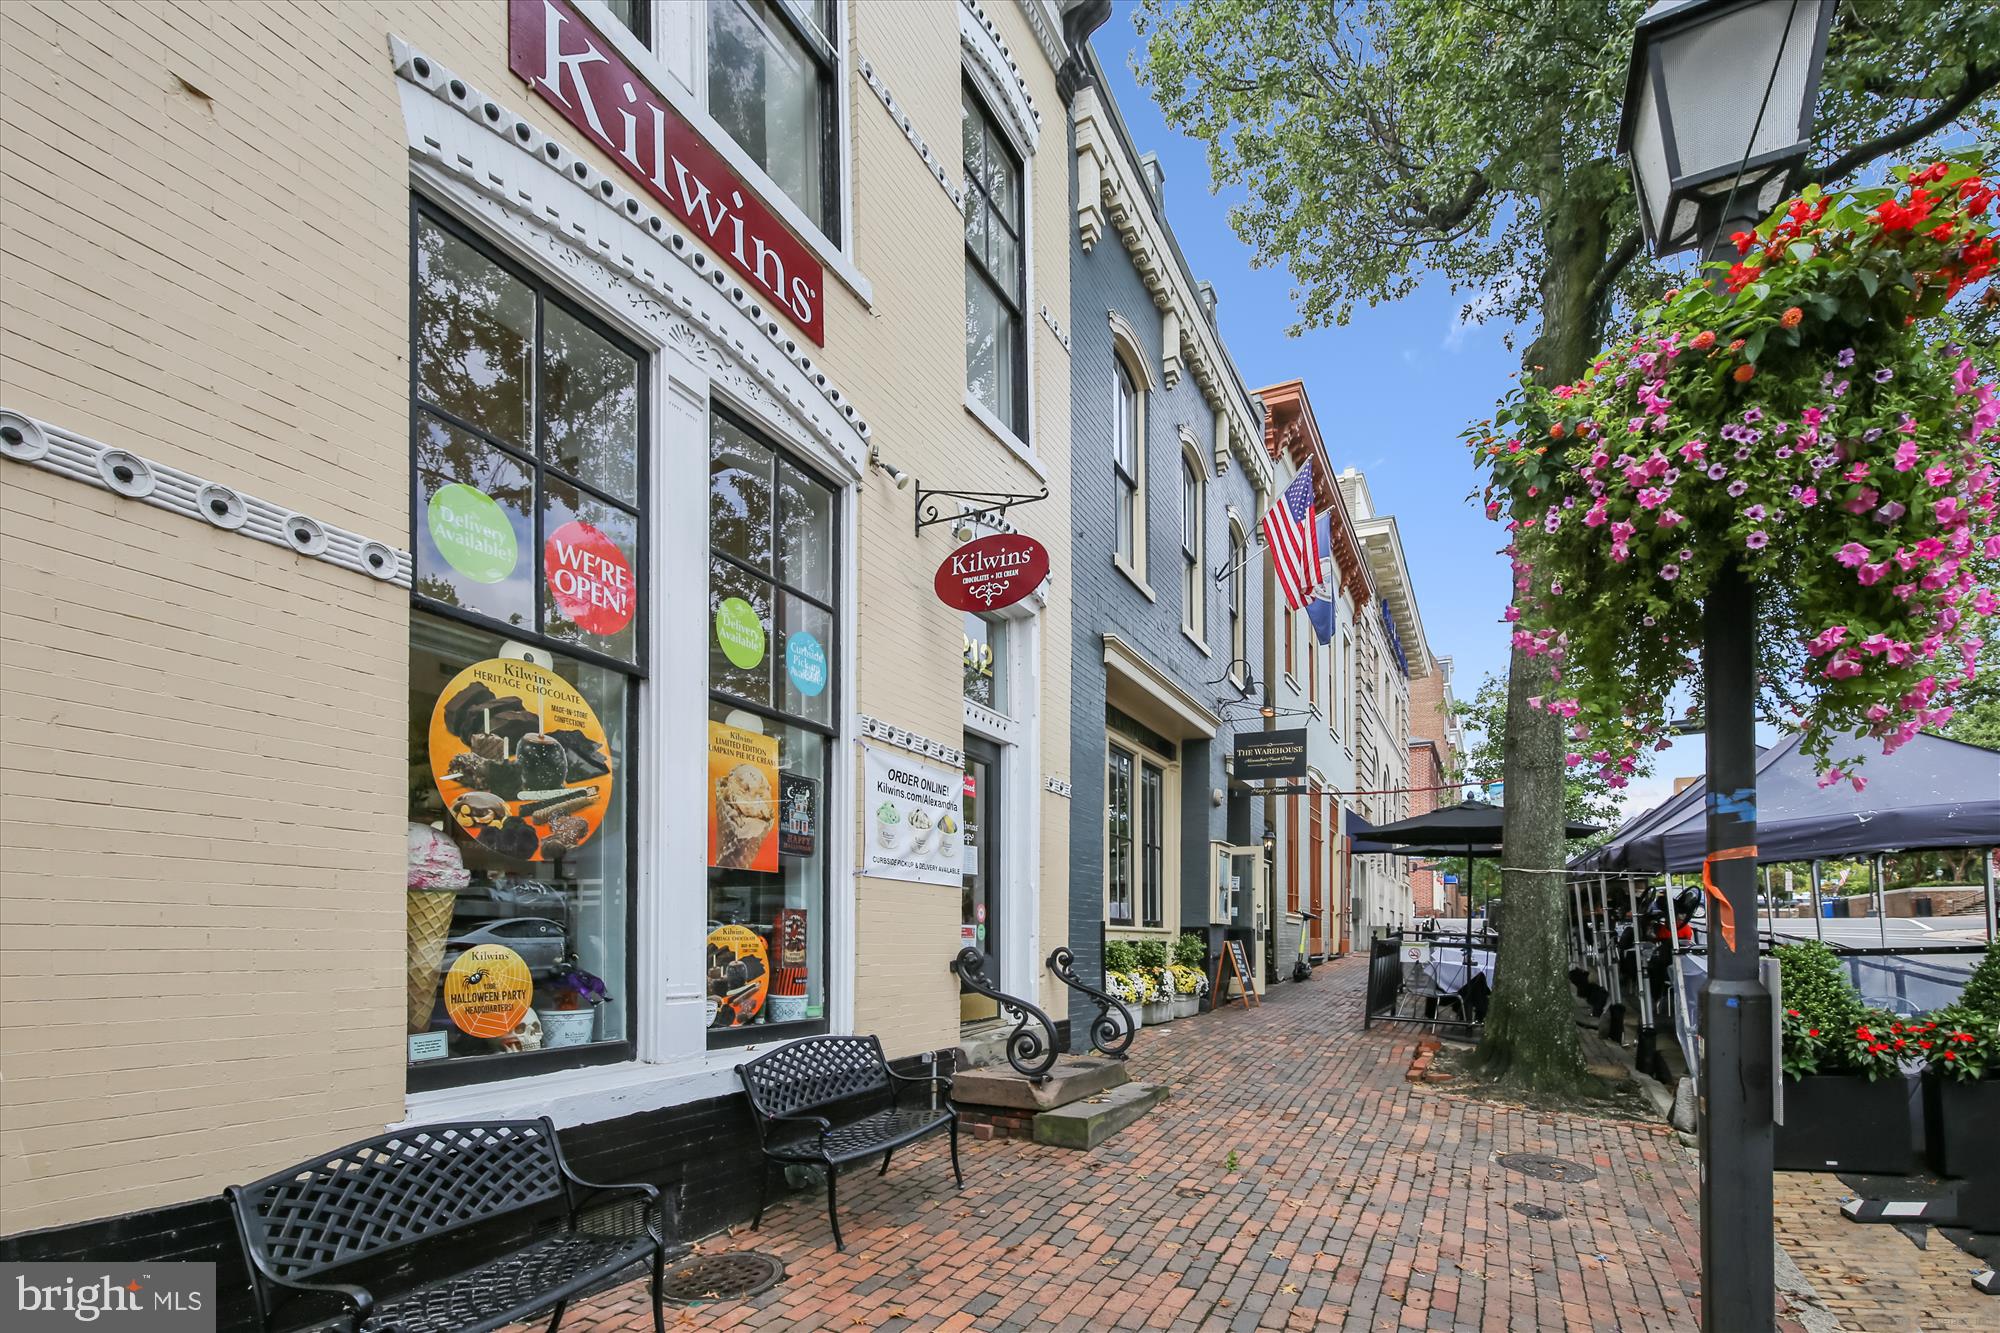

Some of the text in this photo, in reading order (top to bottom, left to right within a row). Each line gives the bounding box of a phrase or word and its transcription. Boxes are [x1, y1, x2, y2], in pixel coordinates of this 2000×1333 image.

[536, 0, 813, 324] Kilwins
[440, 505, 507, 544] Delivery
[435, 523, 513, 563] Available!
[556, 539, 627, 591] WE'RE
[951, 547, 1032, 576] Kilwins
[962, 569, 1019, 584] CHOCOLATES ICE CREAM
[554, 568, 628, 616] OPEN!
[723, 615, 759, 640] Delivery
[473, 669, 581, 705] HERITAGE CHOCOLATE
[503, 662, 552, 687] Kilwins
[708, 744, 735, 757] UMPKIN
[735, 751, 745, 759] PIE
[746, 753, 755, 761] ICE
[715, 737, 767, 756] LIMITED EDITION
[1237, 746, 1304, 757] THE WAREHOUSE
[888, 768, 950, 796] ORDER ONLINE!
[876, 780, 958, 812] Kilwins.com/Alexandria
[872, 855, 897, 866] CURBSIDE
[919, 862, 938, 871] DELIVERY
[938, 866, 960, 875] AVAILABLE
[471, 951, 510, 961] Kilwins
[450, 990, 527, 1004] HALLOWEEN PARTY
